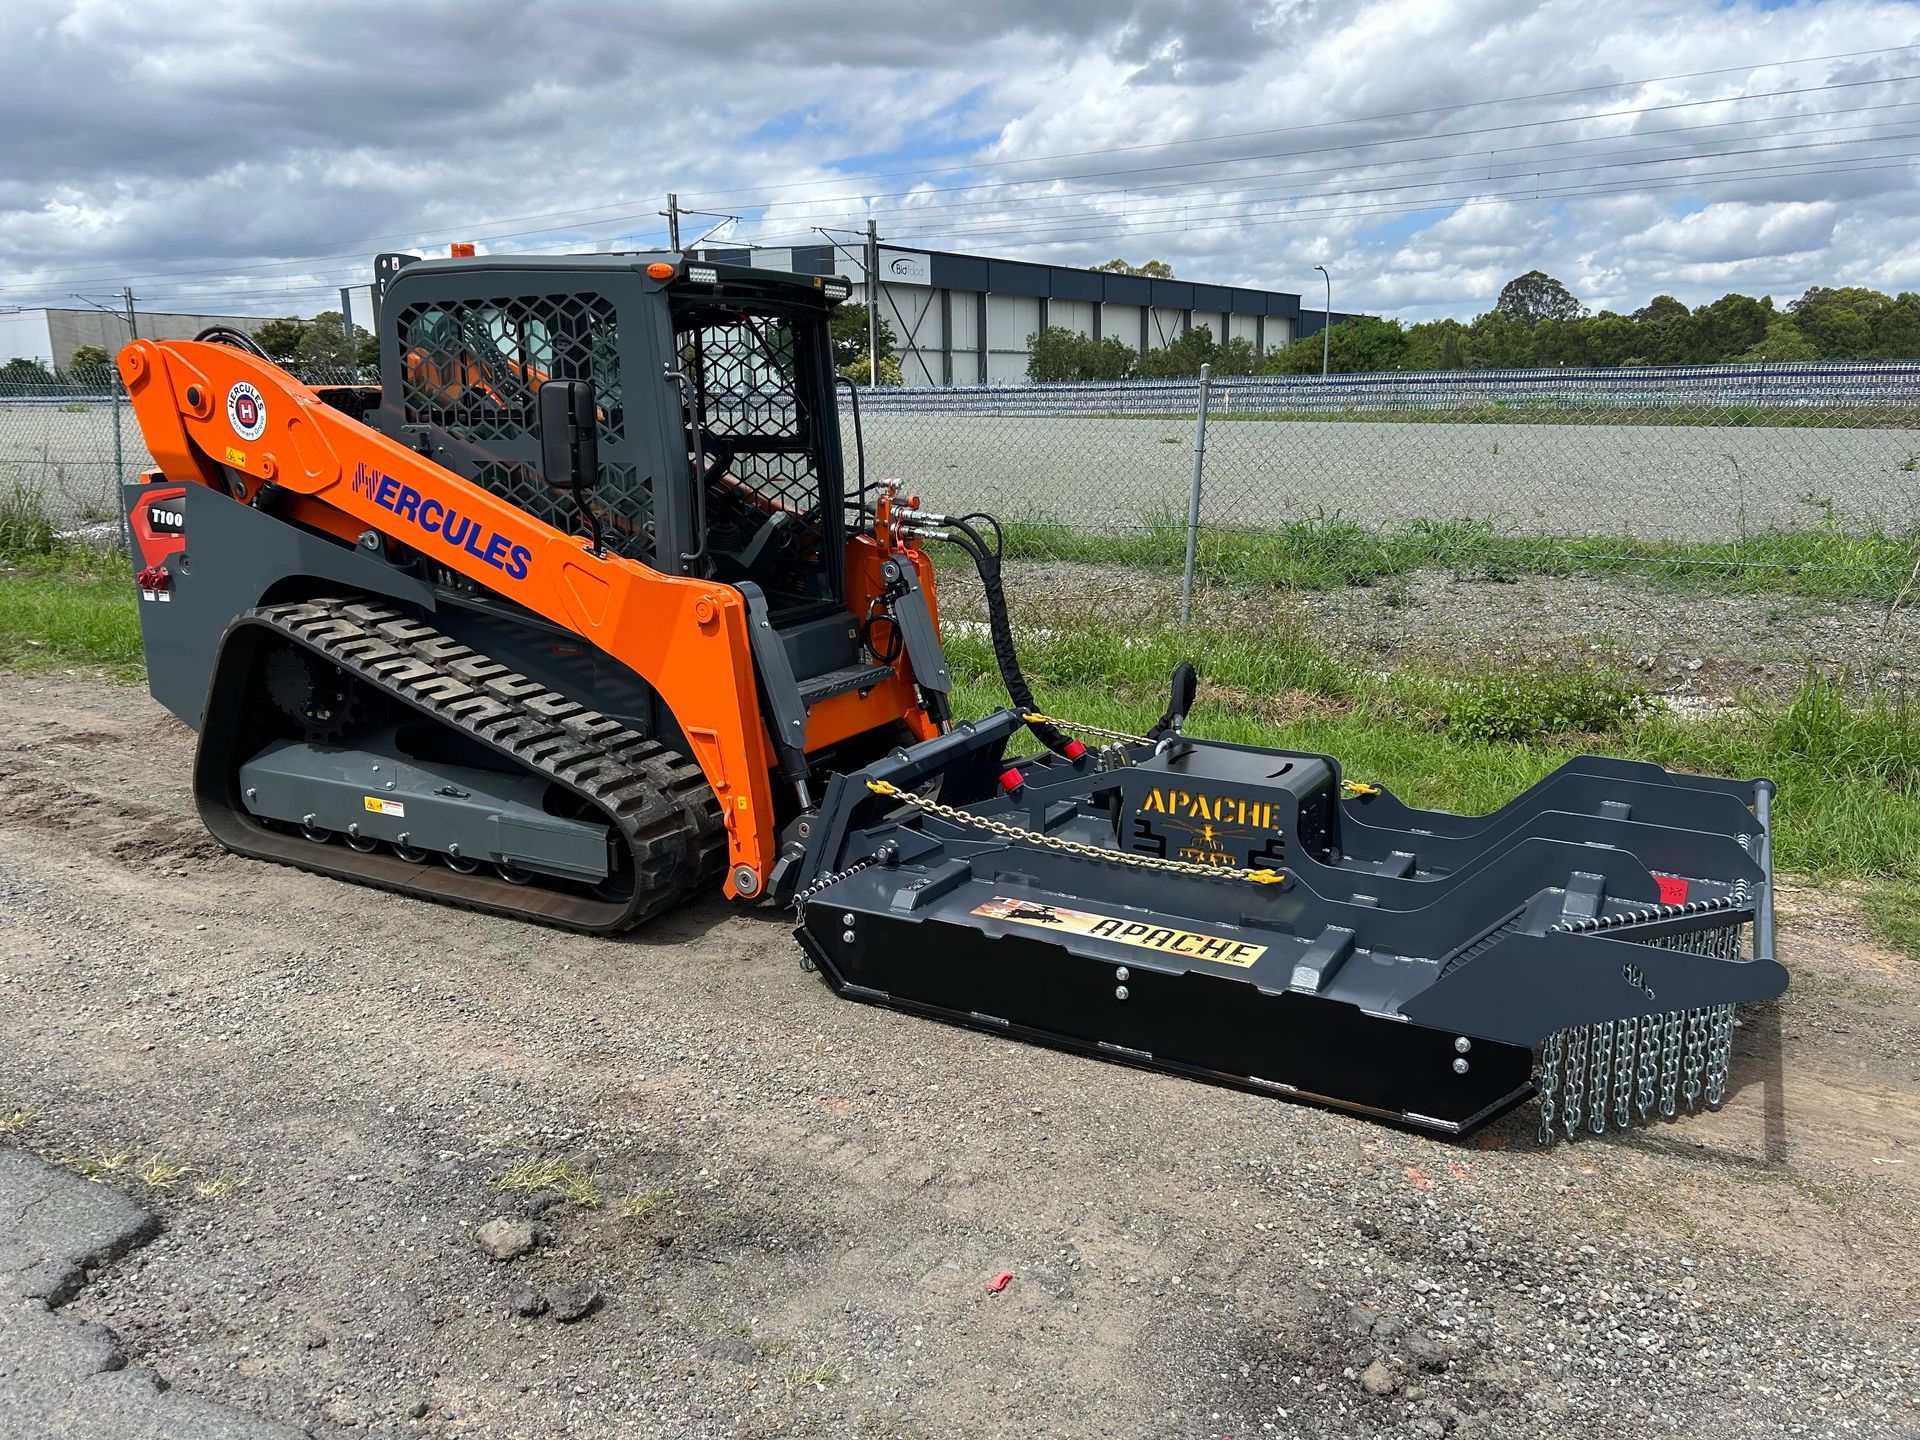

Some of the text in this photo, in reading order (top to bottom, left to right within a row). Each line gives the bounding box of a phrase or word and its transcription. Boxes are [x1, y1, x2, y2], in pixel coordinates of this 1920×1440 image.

[229, 384, 263, 411] HERCULES
[241, 403, 253, 419] H
[231, 413, 254, 438] Machinery
[152, 508, 183, 527] T100
[352, 461, 533, 581] HERCULES
[1143, 787, 1281, 830] APACHE
[1089, 919, 1258, 962] APACHE
